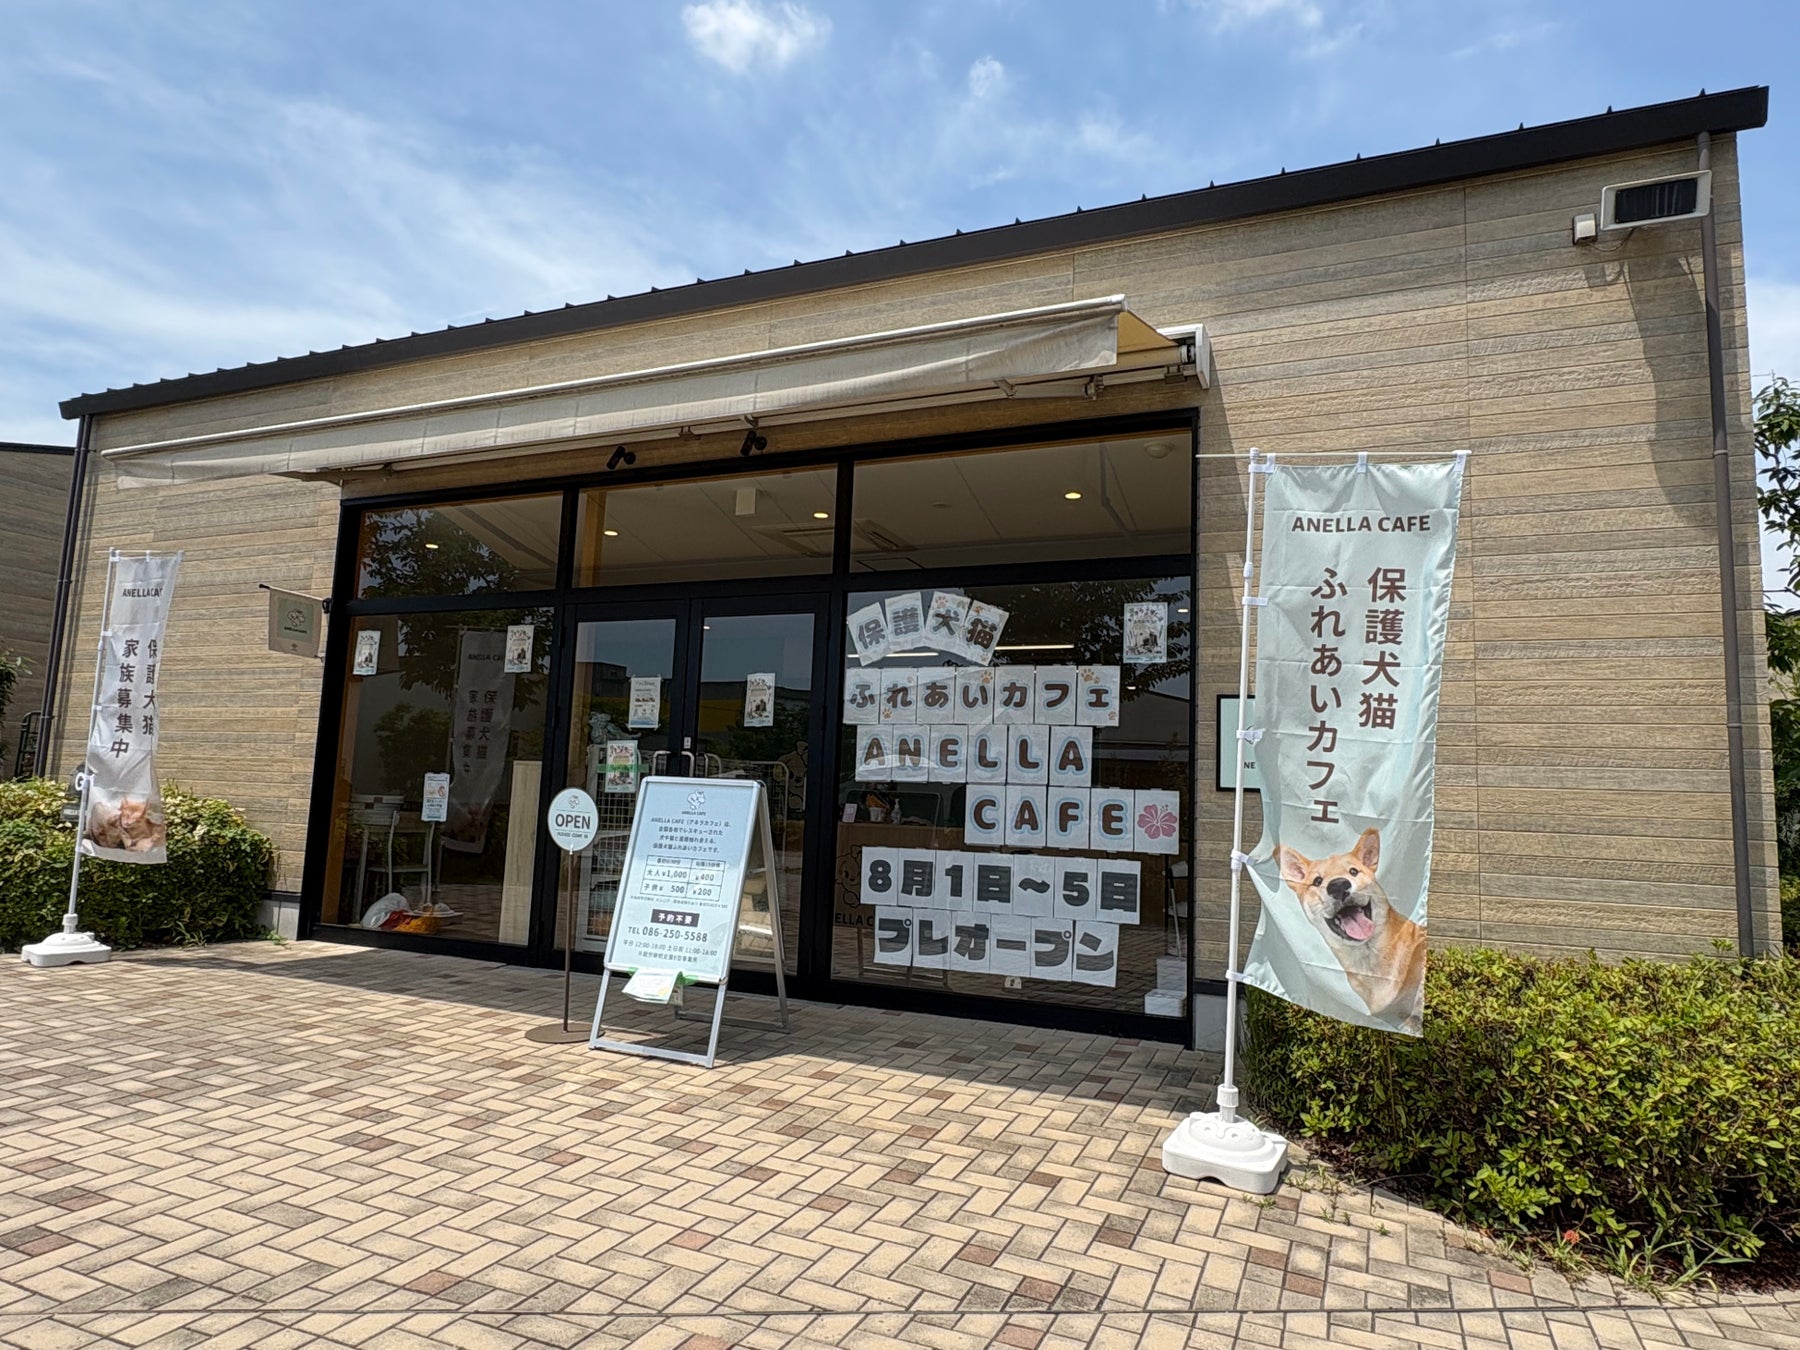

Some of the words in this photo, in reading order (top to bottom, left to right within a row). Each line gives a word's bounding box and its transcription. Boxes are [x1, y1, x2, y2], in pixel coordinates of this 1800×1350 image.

[1291, 516, 1372, 533] ANELLA
[1377, 515, 1431, 532] CAFE
[151, 588, 163, 597] CA
[856, 607, 998, 647] 保護犬猫
[1357, 566, 1407, 730] 保護犬猫
[110, 638, 140, 759] 家族募集中
[849, 682, 1111, 709] ふれあいカフェ
[1306, 567, 1348, 825] ふれあいカフェ
[863, 738, 1085, 773] ANELLA
[555, 813, 591, 830] OPEN
[973, 800, 1125, 836] CAFE
[628, 926, 641, 935] TEL
[642, 926, 708, 943] 086-250-5588
[877, 918, 1114, 972] プレオープン
